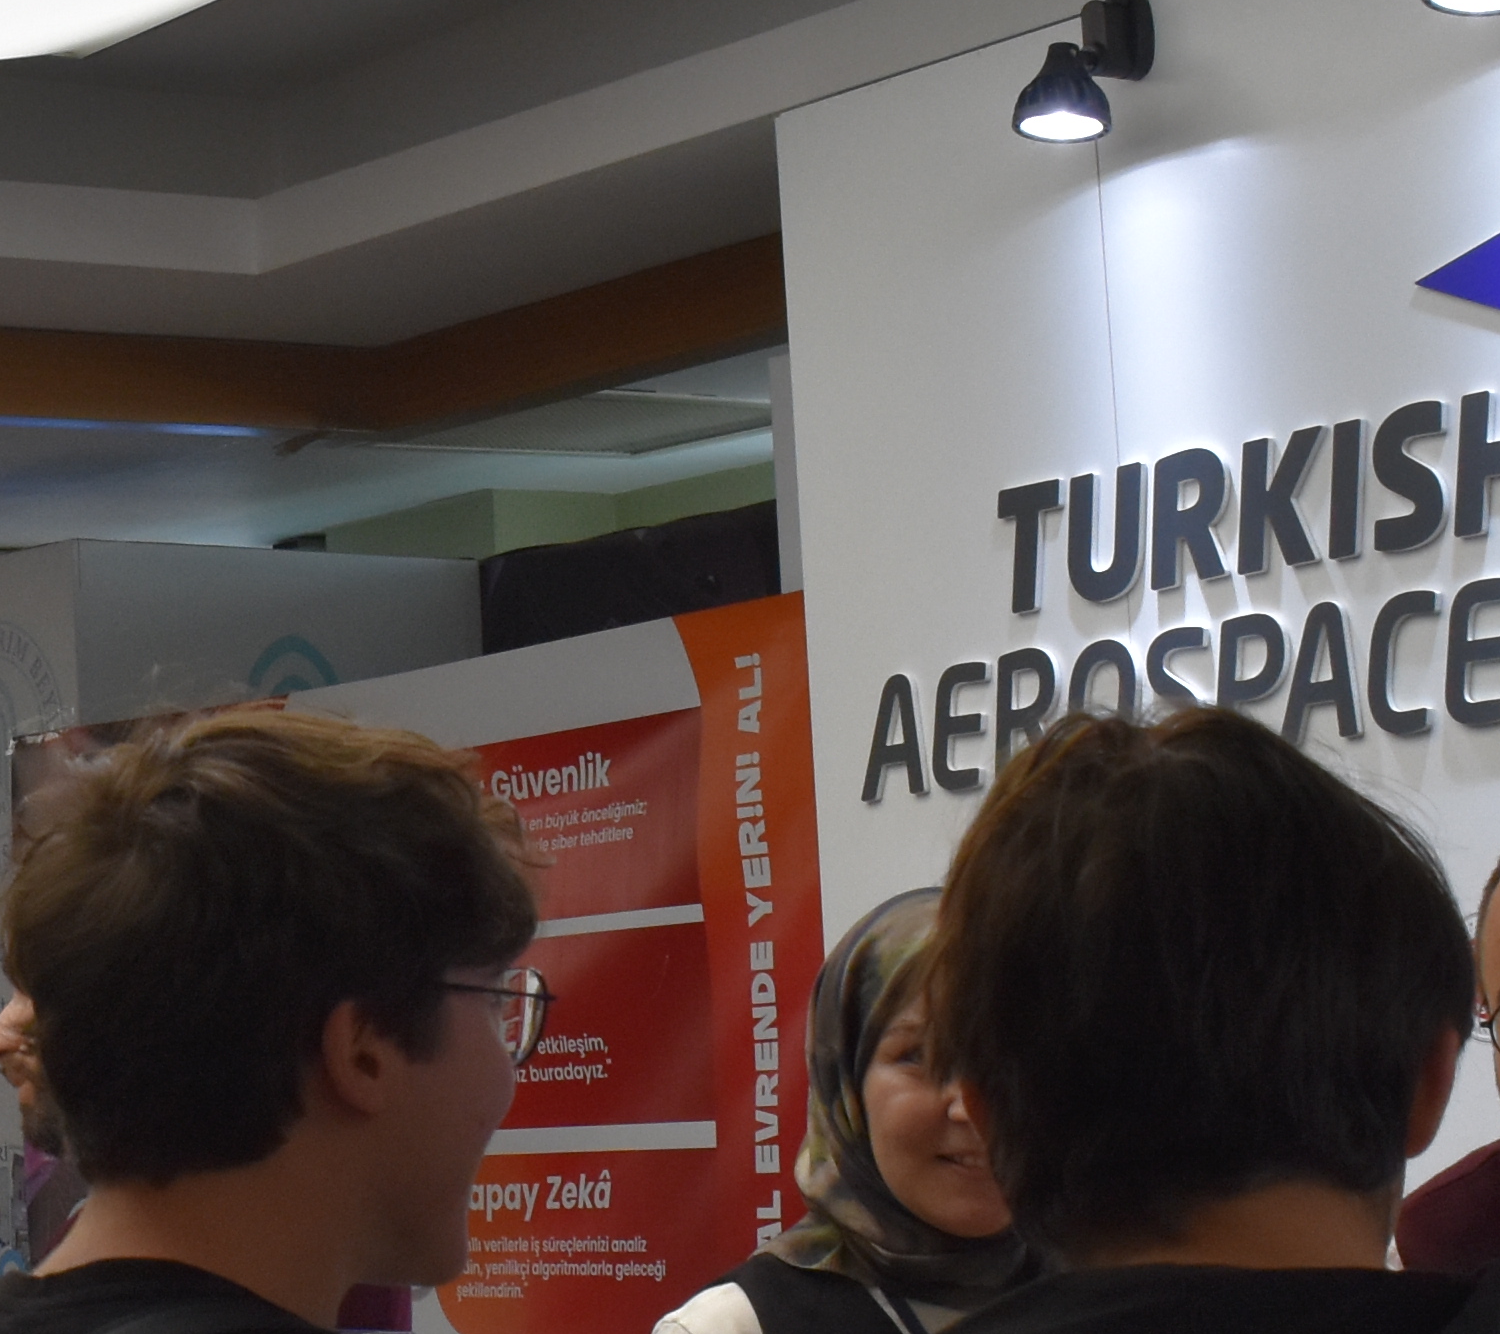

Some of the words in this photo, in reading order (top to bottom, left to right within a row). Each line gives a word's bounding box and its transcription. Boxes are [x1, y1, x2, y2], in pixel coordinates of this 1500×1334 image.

[734, 652, 763, 733] AL!
[491, 752, 612, 801] Güvenlik
[537, 1033, 609, 1058] etkileşim,
[750, 940, 781, 1174] EVRENDE
[546, 1169, 612, 1210] Zekâ
[611, 1235, 647, 1253] analiz
[532, 1259, 613, 1281] algoritmalarla
[615, 1259, 667, 1282] geleceği
